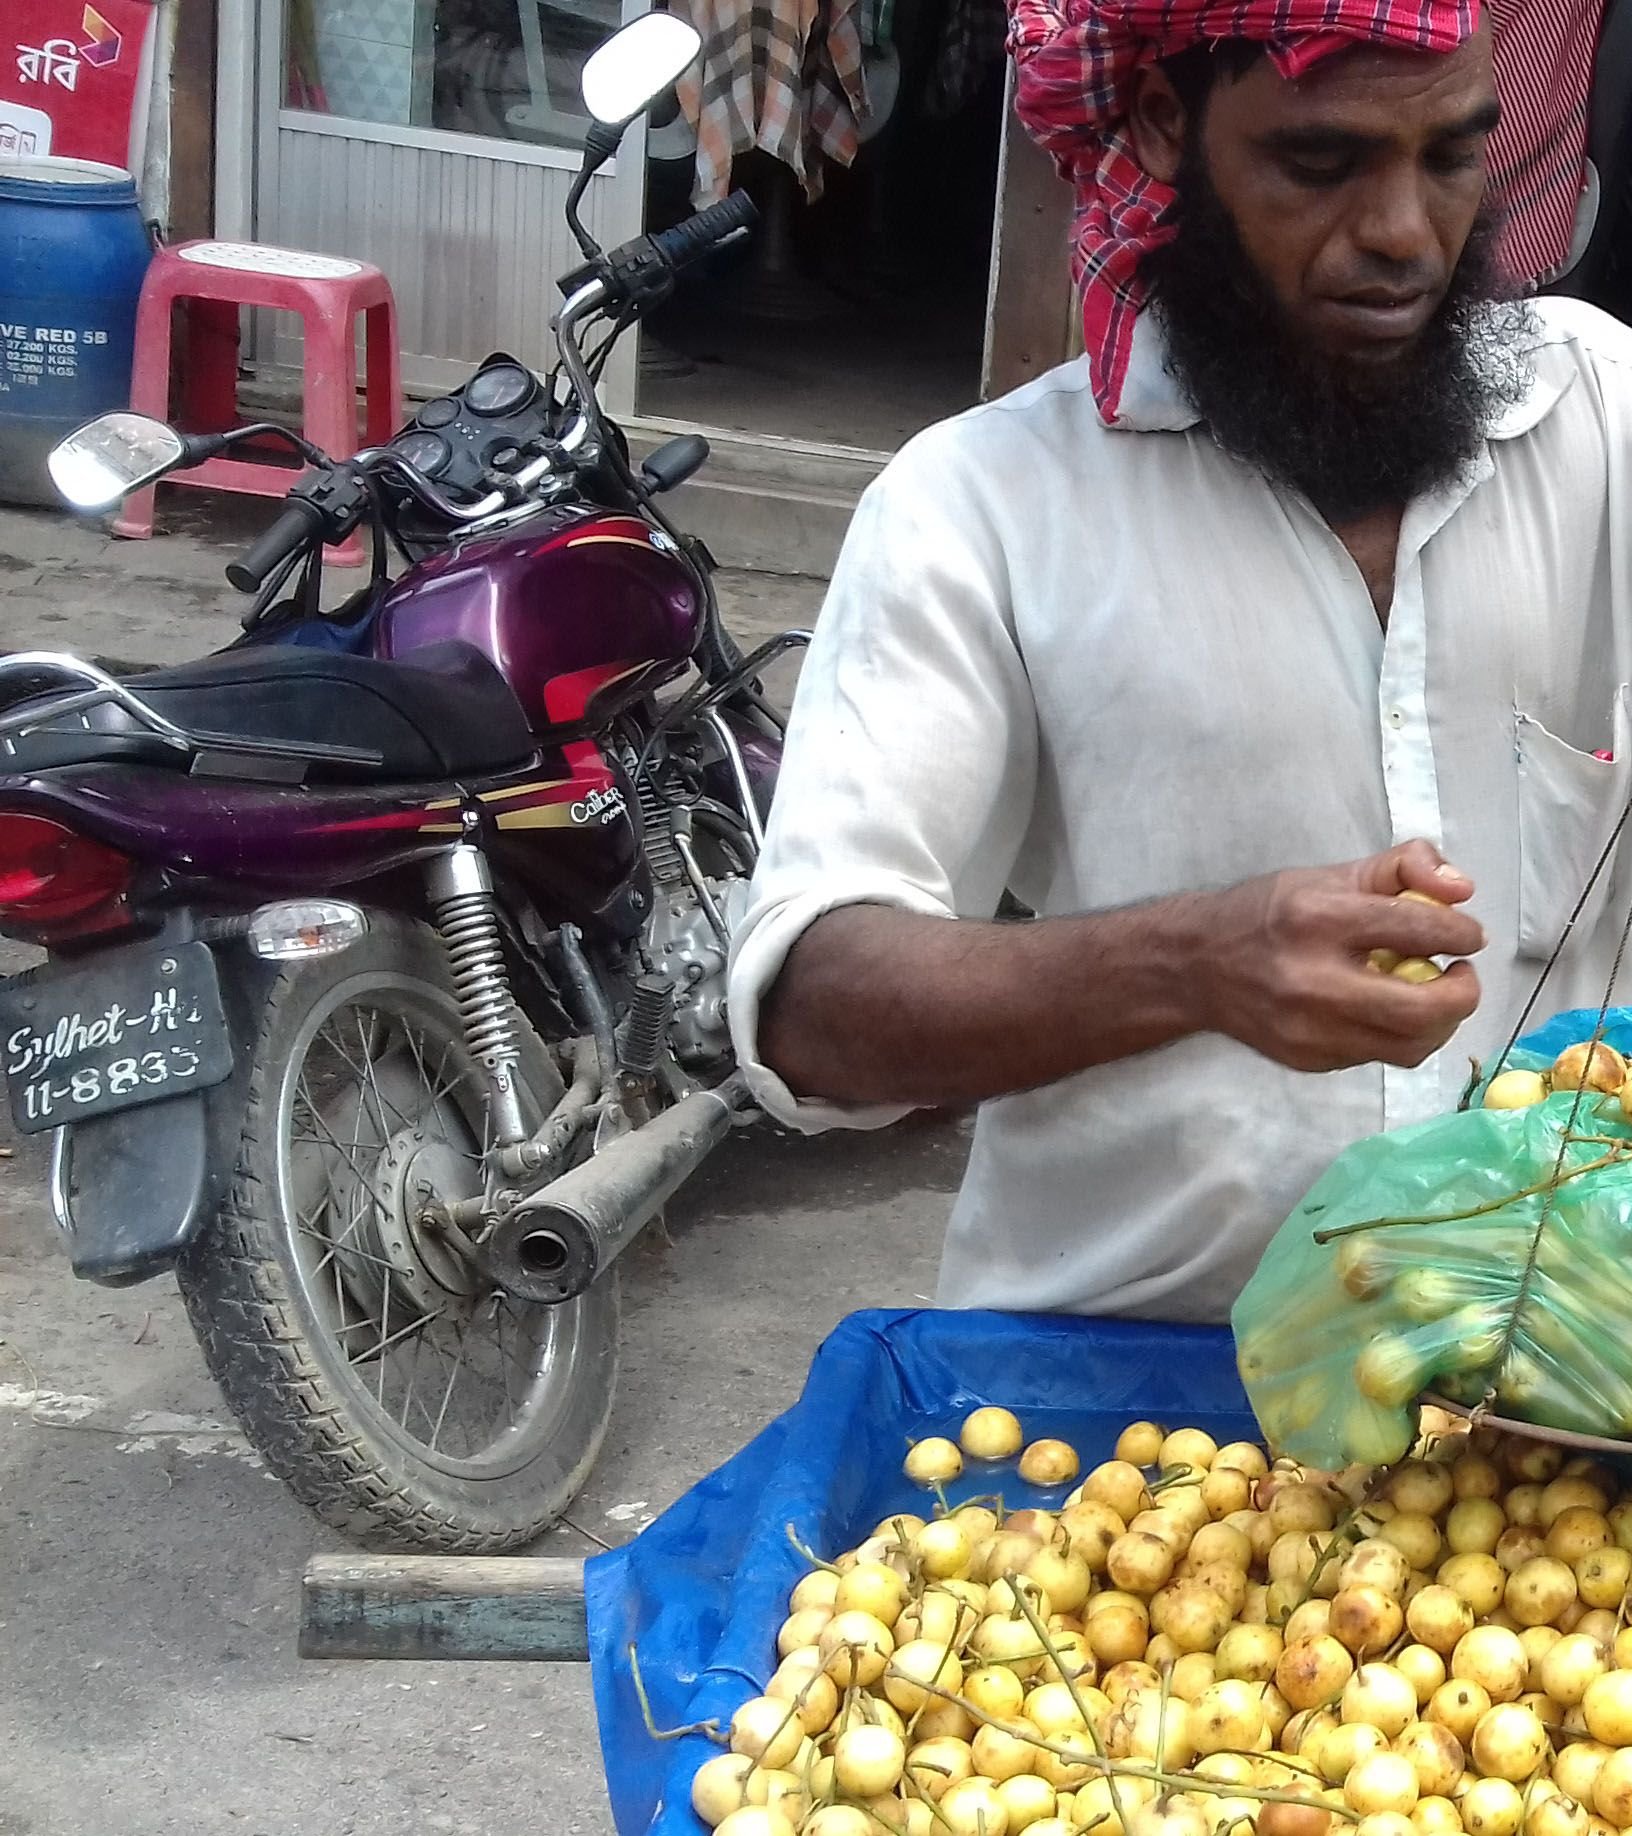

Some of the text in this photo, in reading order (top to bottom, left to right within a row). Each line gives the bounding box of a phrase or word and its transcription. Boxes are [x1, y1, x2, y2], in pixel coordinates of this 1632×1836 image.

[16, 39, 81, 92] রবি
[35, 328, 77, 343] RED
[82, 330, 109, 345] 5B
